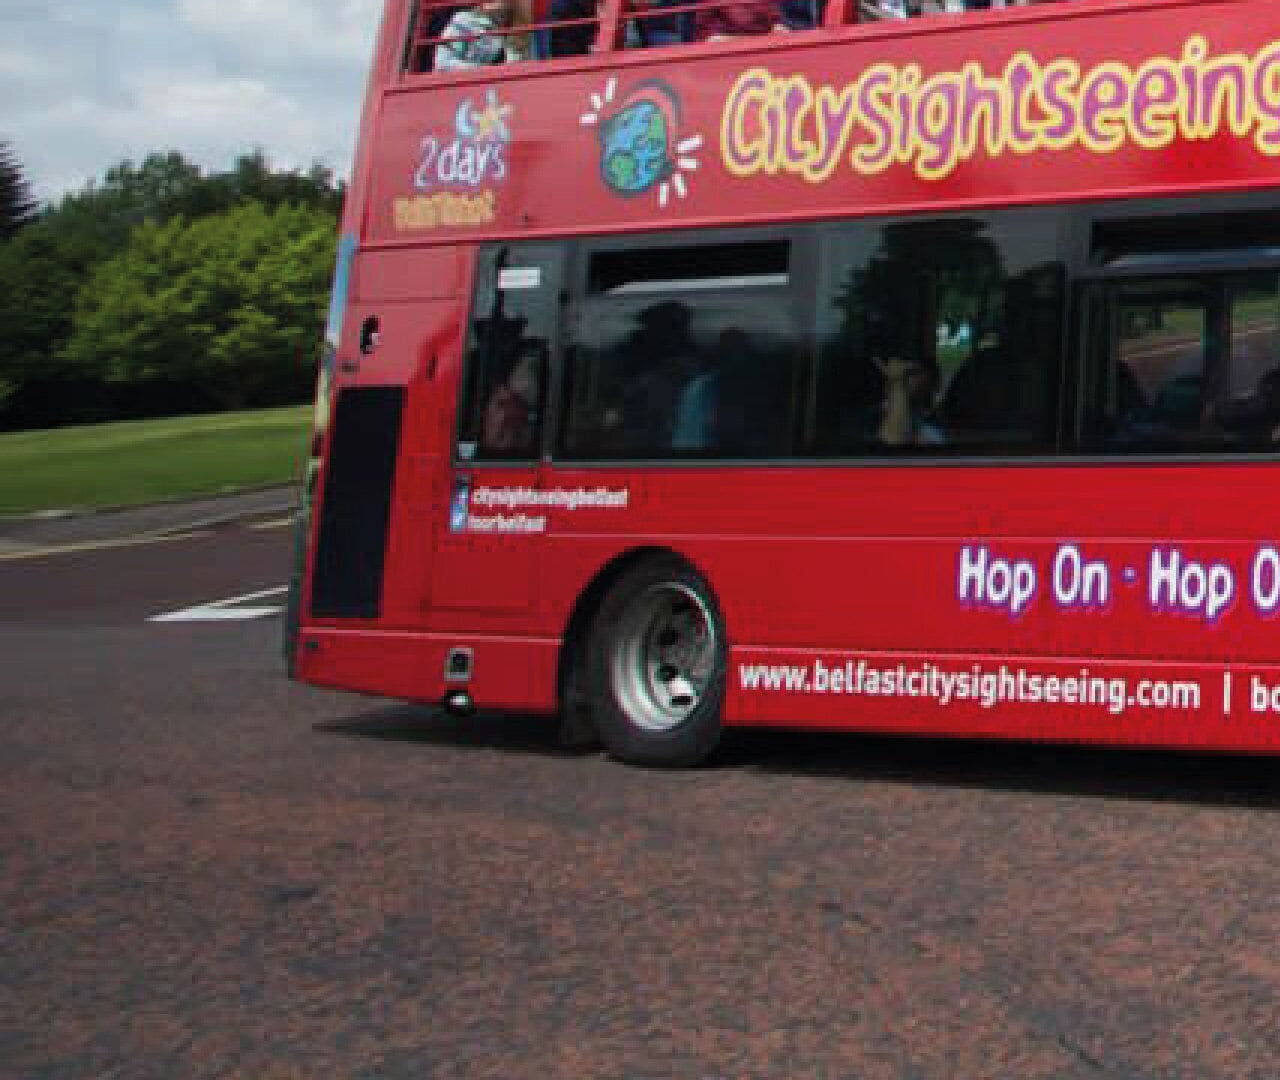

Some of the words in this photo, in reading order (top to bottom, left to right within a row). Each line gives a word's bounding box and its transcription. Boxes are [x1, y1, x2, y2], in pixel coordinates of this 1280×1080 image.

[957, 542, 1037, 612] Hop
[1053, 541, 1109, 605] On
[1149, 546, 1236, 618] Hop
[738, 659, 1201, 714] www.belfastcitysightseeing.com
